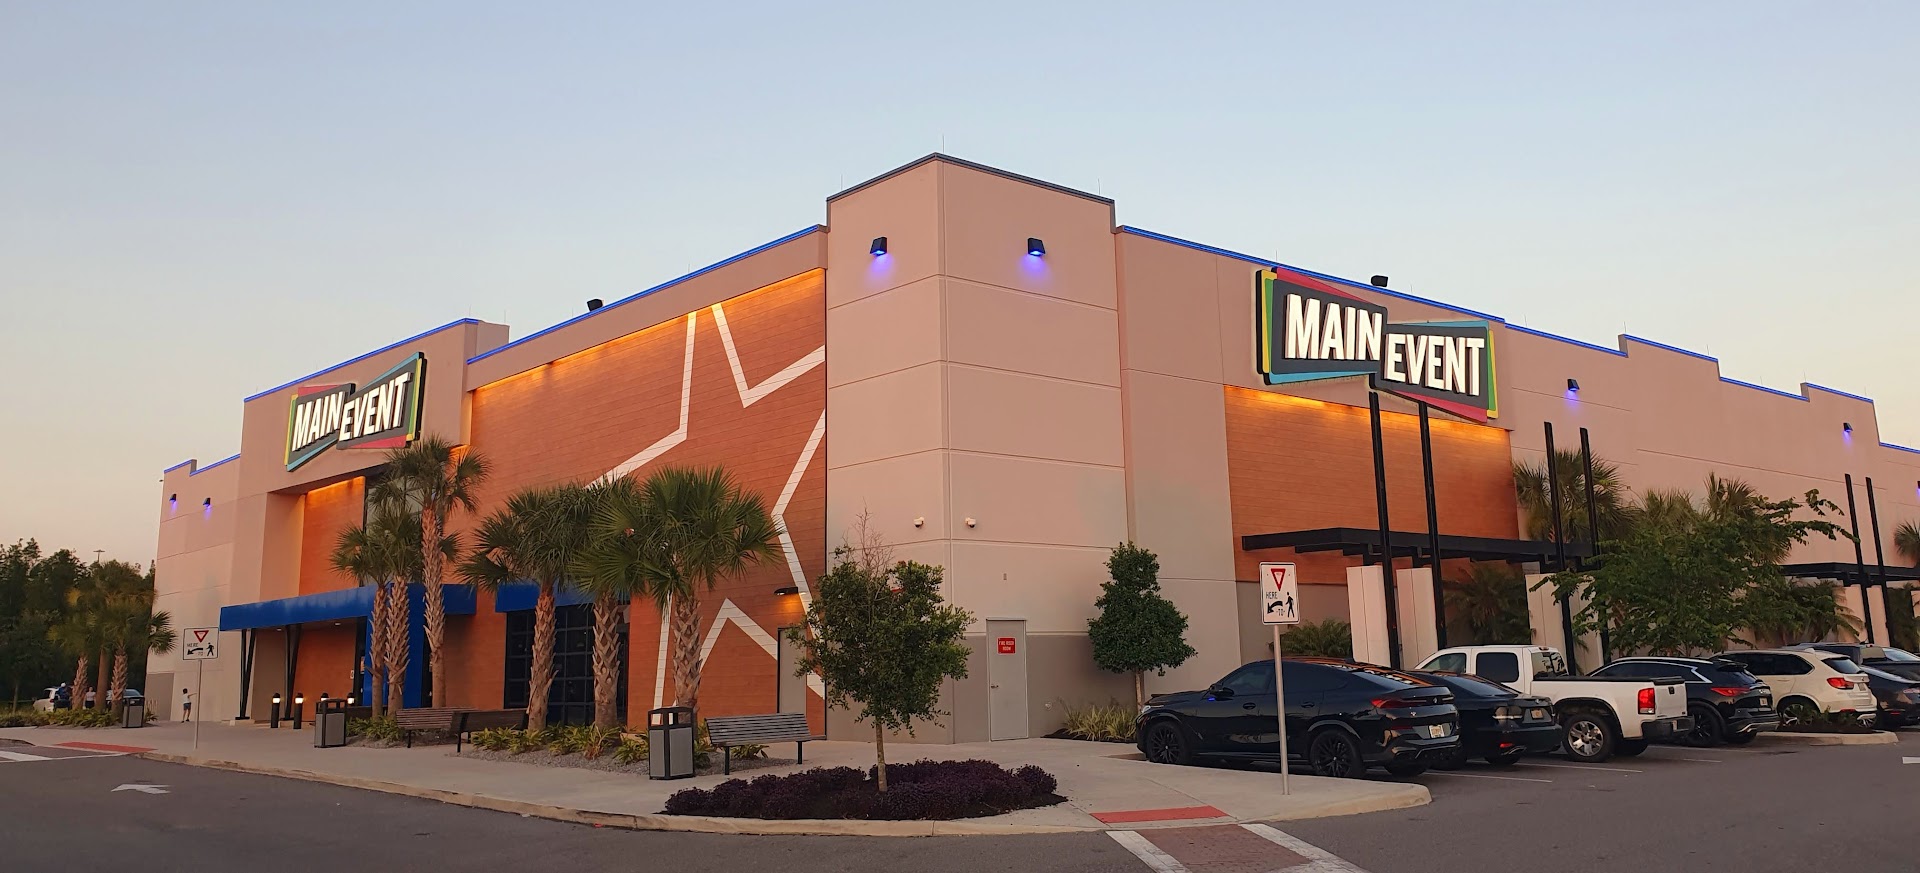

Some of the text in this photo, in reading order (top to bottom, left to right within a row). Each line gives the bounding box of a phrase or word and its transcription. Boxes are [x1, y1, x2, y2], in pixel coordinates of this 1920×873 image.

[1284, 294, 1485, 396] MAIN EVENT
[291, 371, 411, 452] MAIN EVENT
